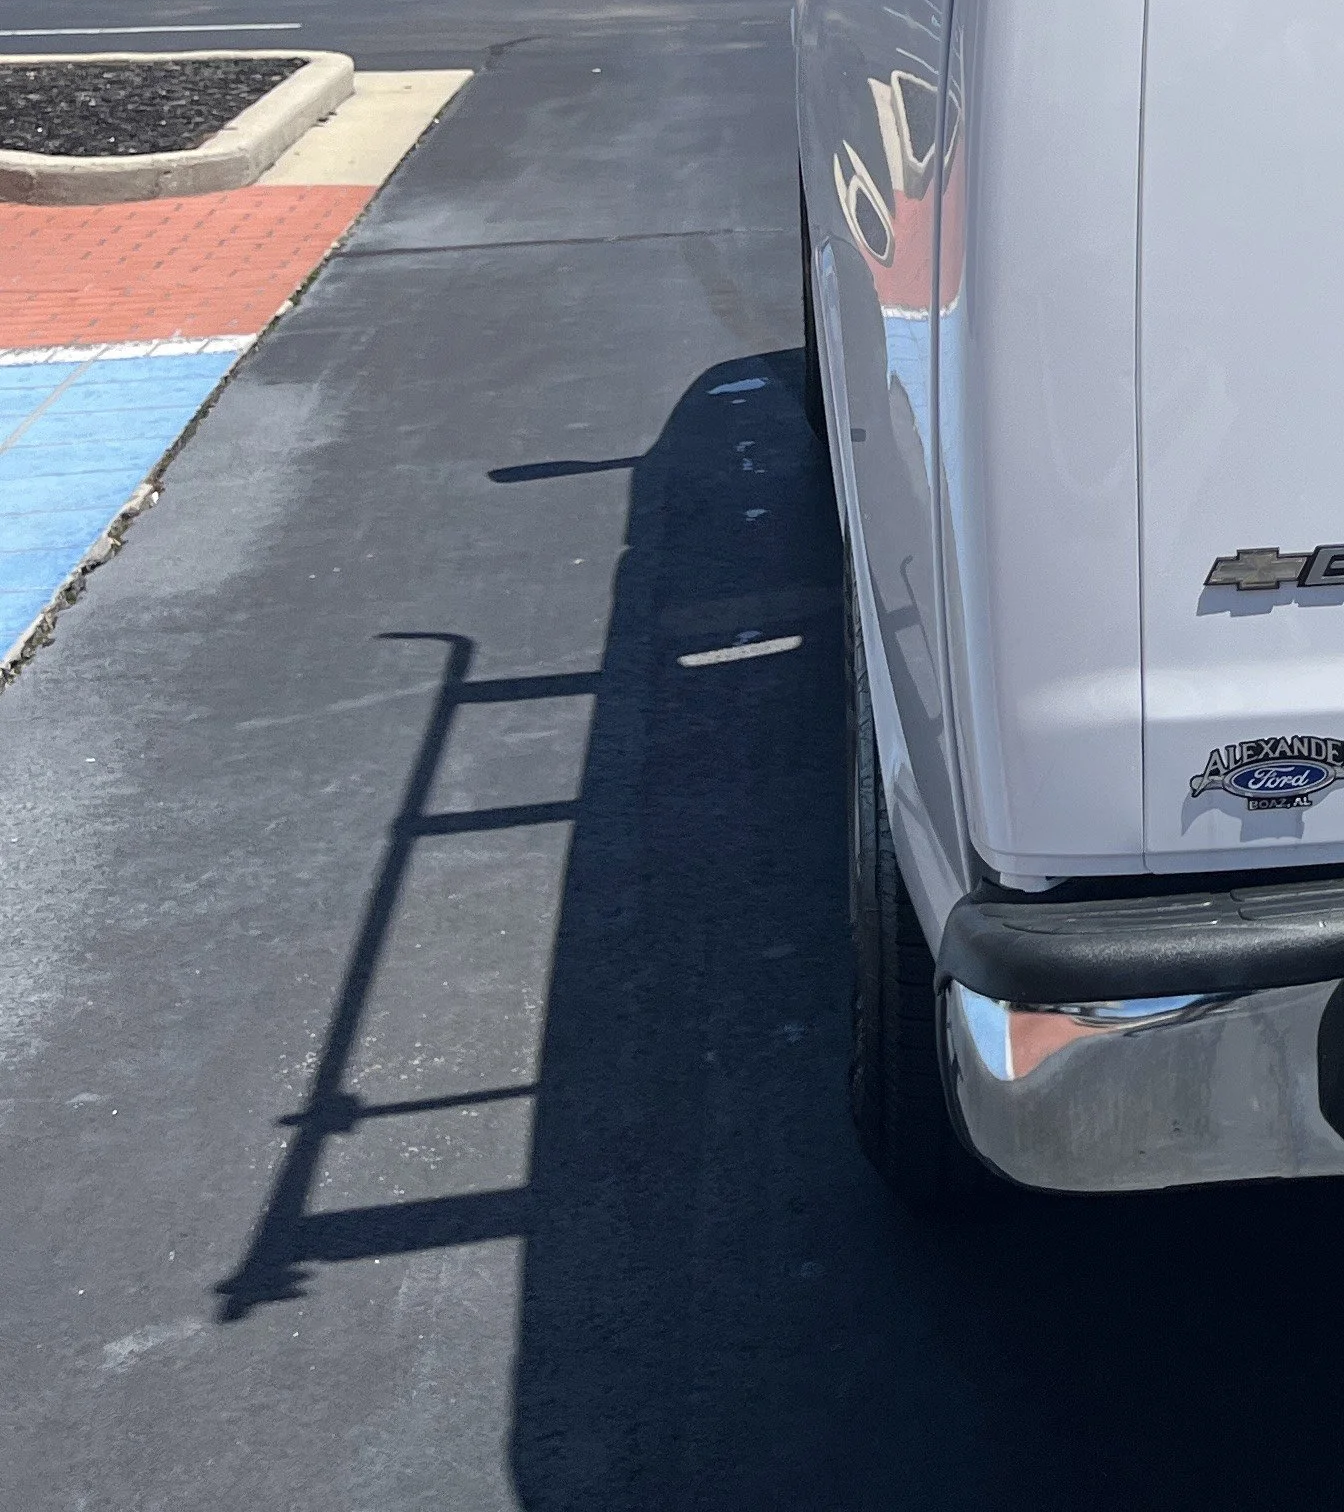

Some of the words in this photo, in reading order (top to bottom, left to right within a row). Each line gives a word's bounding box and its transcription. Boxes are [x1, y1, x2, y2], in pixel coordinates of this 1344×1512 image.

[1248, 766, 1310, 789] Ford
[1249, 799, 1291, 811] BOAZ,
[1293, 797, 1312, 807] AL
